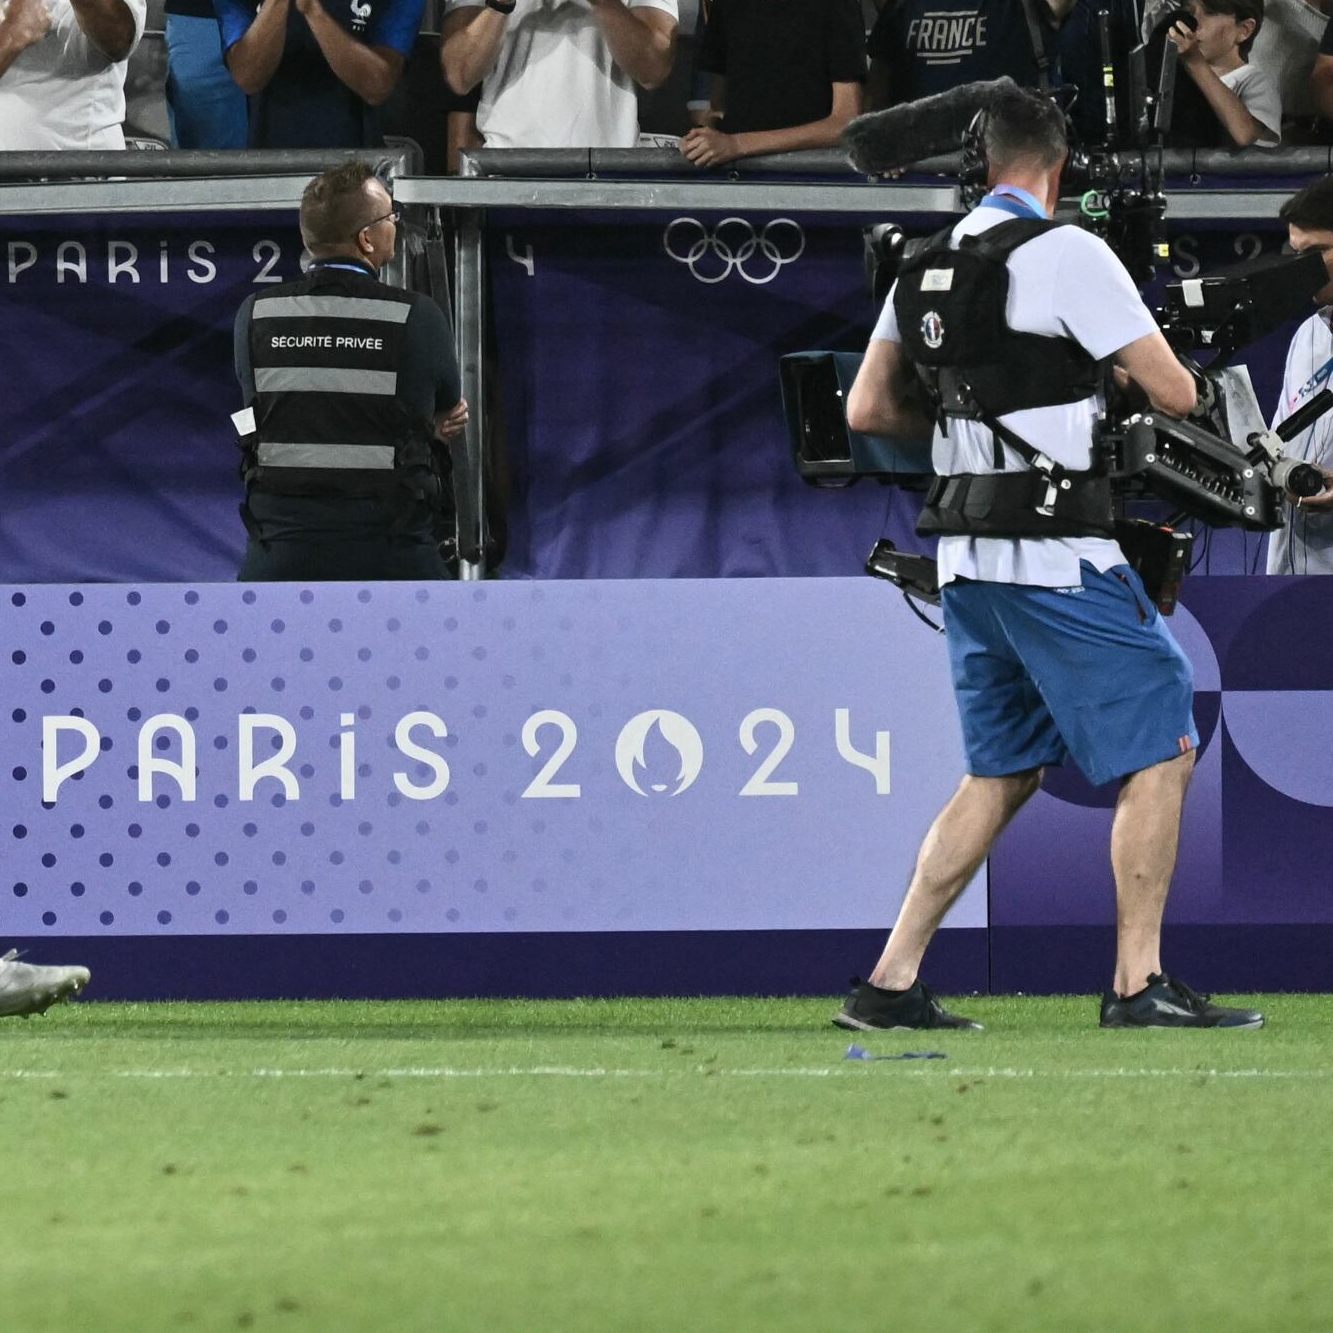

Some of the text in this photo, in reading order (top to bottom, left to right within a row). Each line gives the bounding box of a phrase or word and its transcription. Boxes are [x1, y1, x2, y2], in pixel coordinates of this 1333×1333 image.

[906, 16, 989, 50] FRANCE
[271, 334, 383, 350] SÉCURITÉ PRIVÉE
[522, 707, 892, 799] 2024
